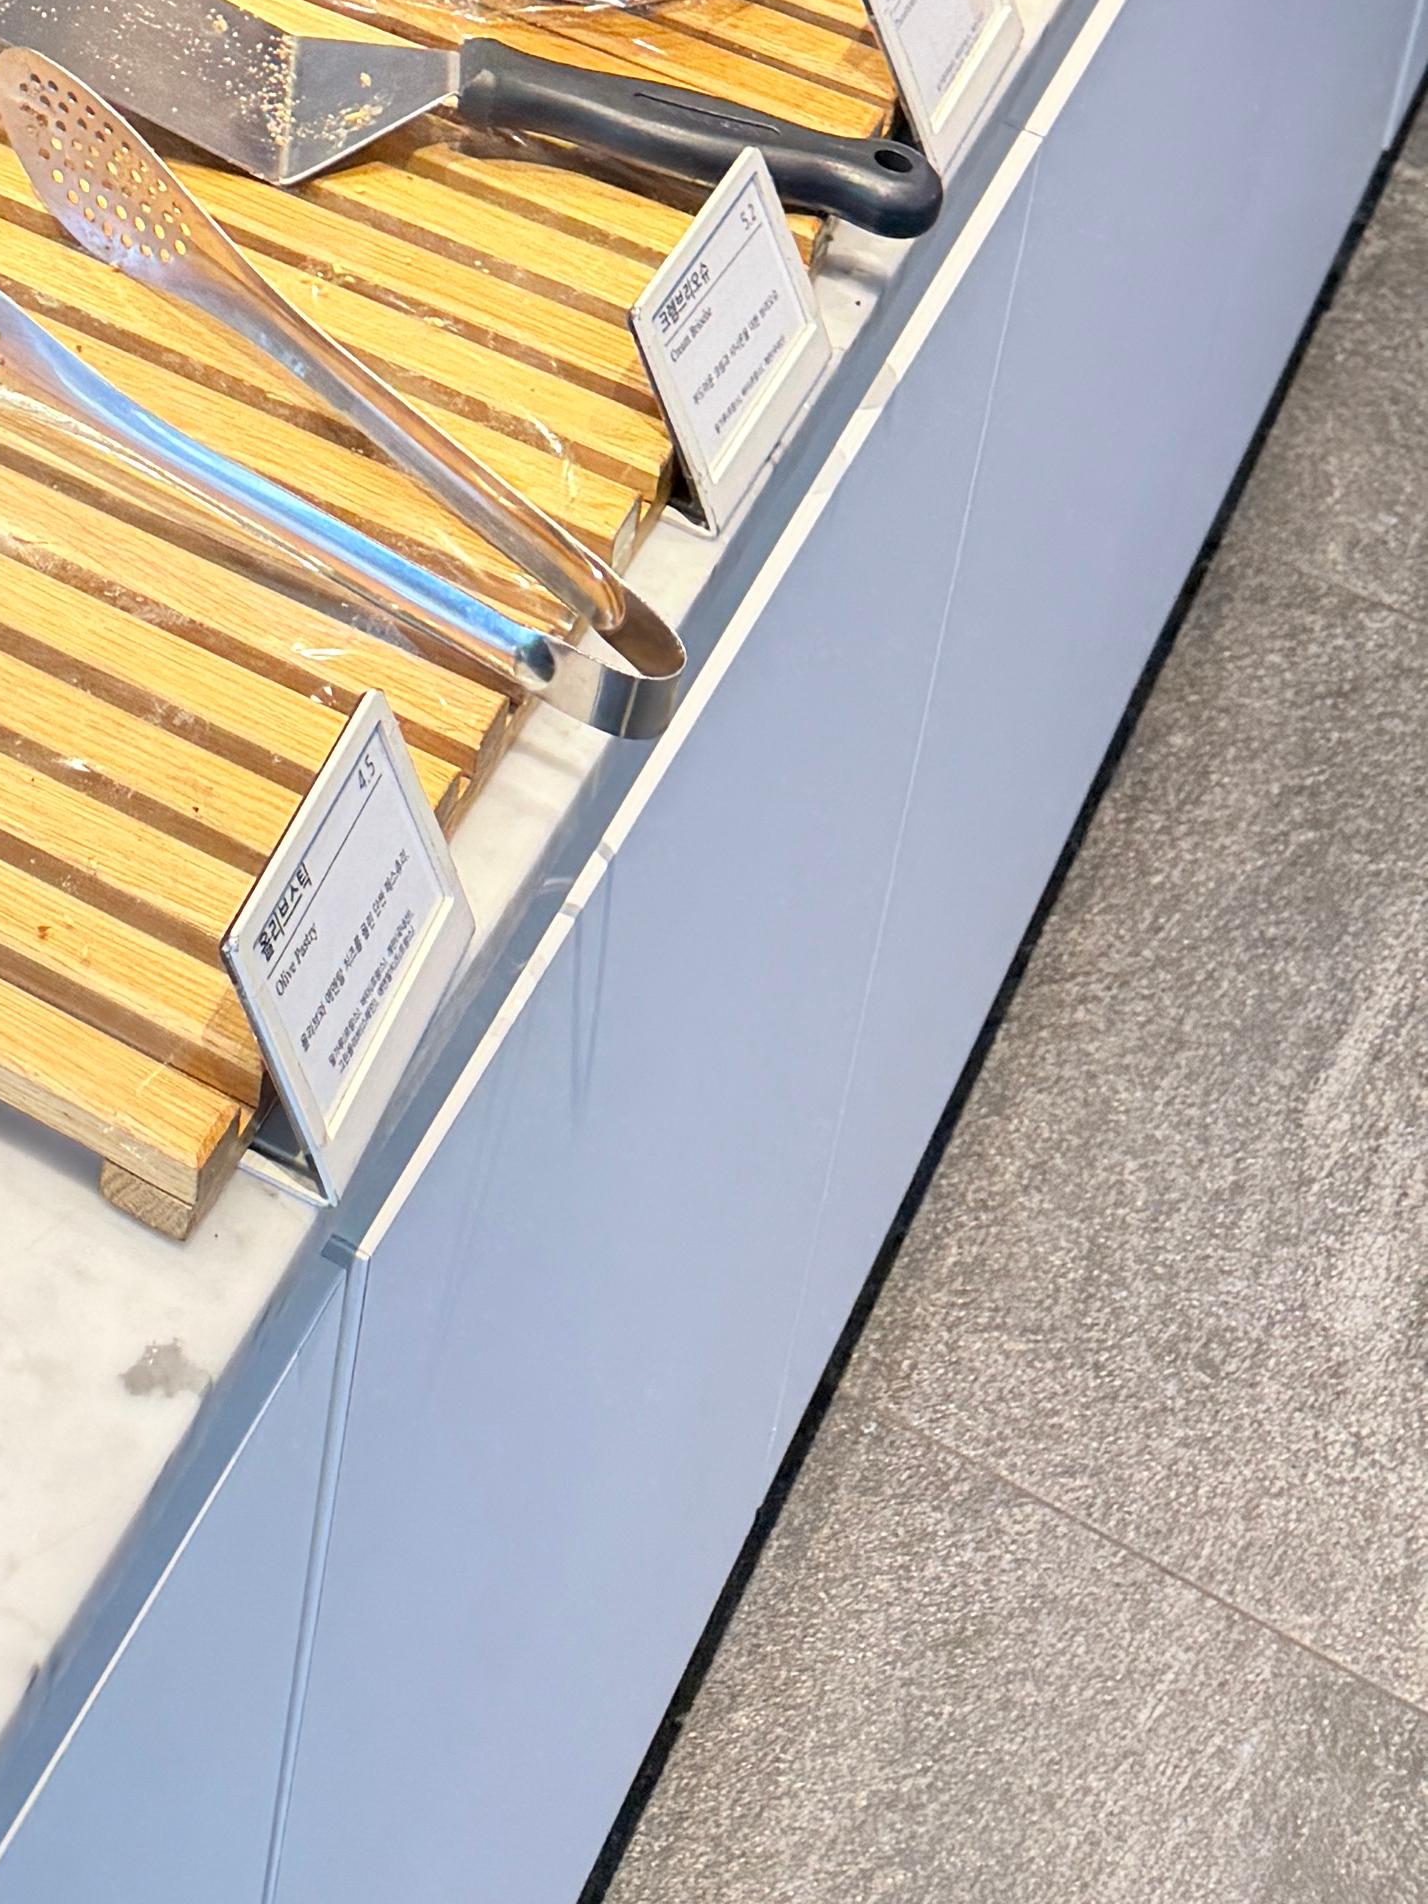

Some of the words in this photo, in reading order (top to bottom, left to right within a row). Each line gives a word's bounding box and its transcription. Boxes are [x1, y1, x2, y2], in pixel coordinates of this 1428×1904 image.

[740, 201, 759, 232] 5.2
[258, 859, 314, 963] 올리브스틱
[357, 754, 377, 793] 4.5
[274, 958, 298, 999] Olive
[293, 921, 319, 970] Pastry
